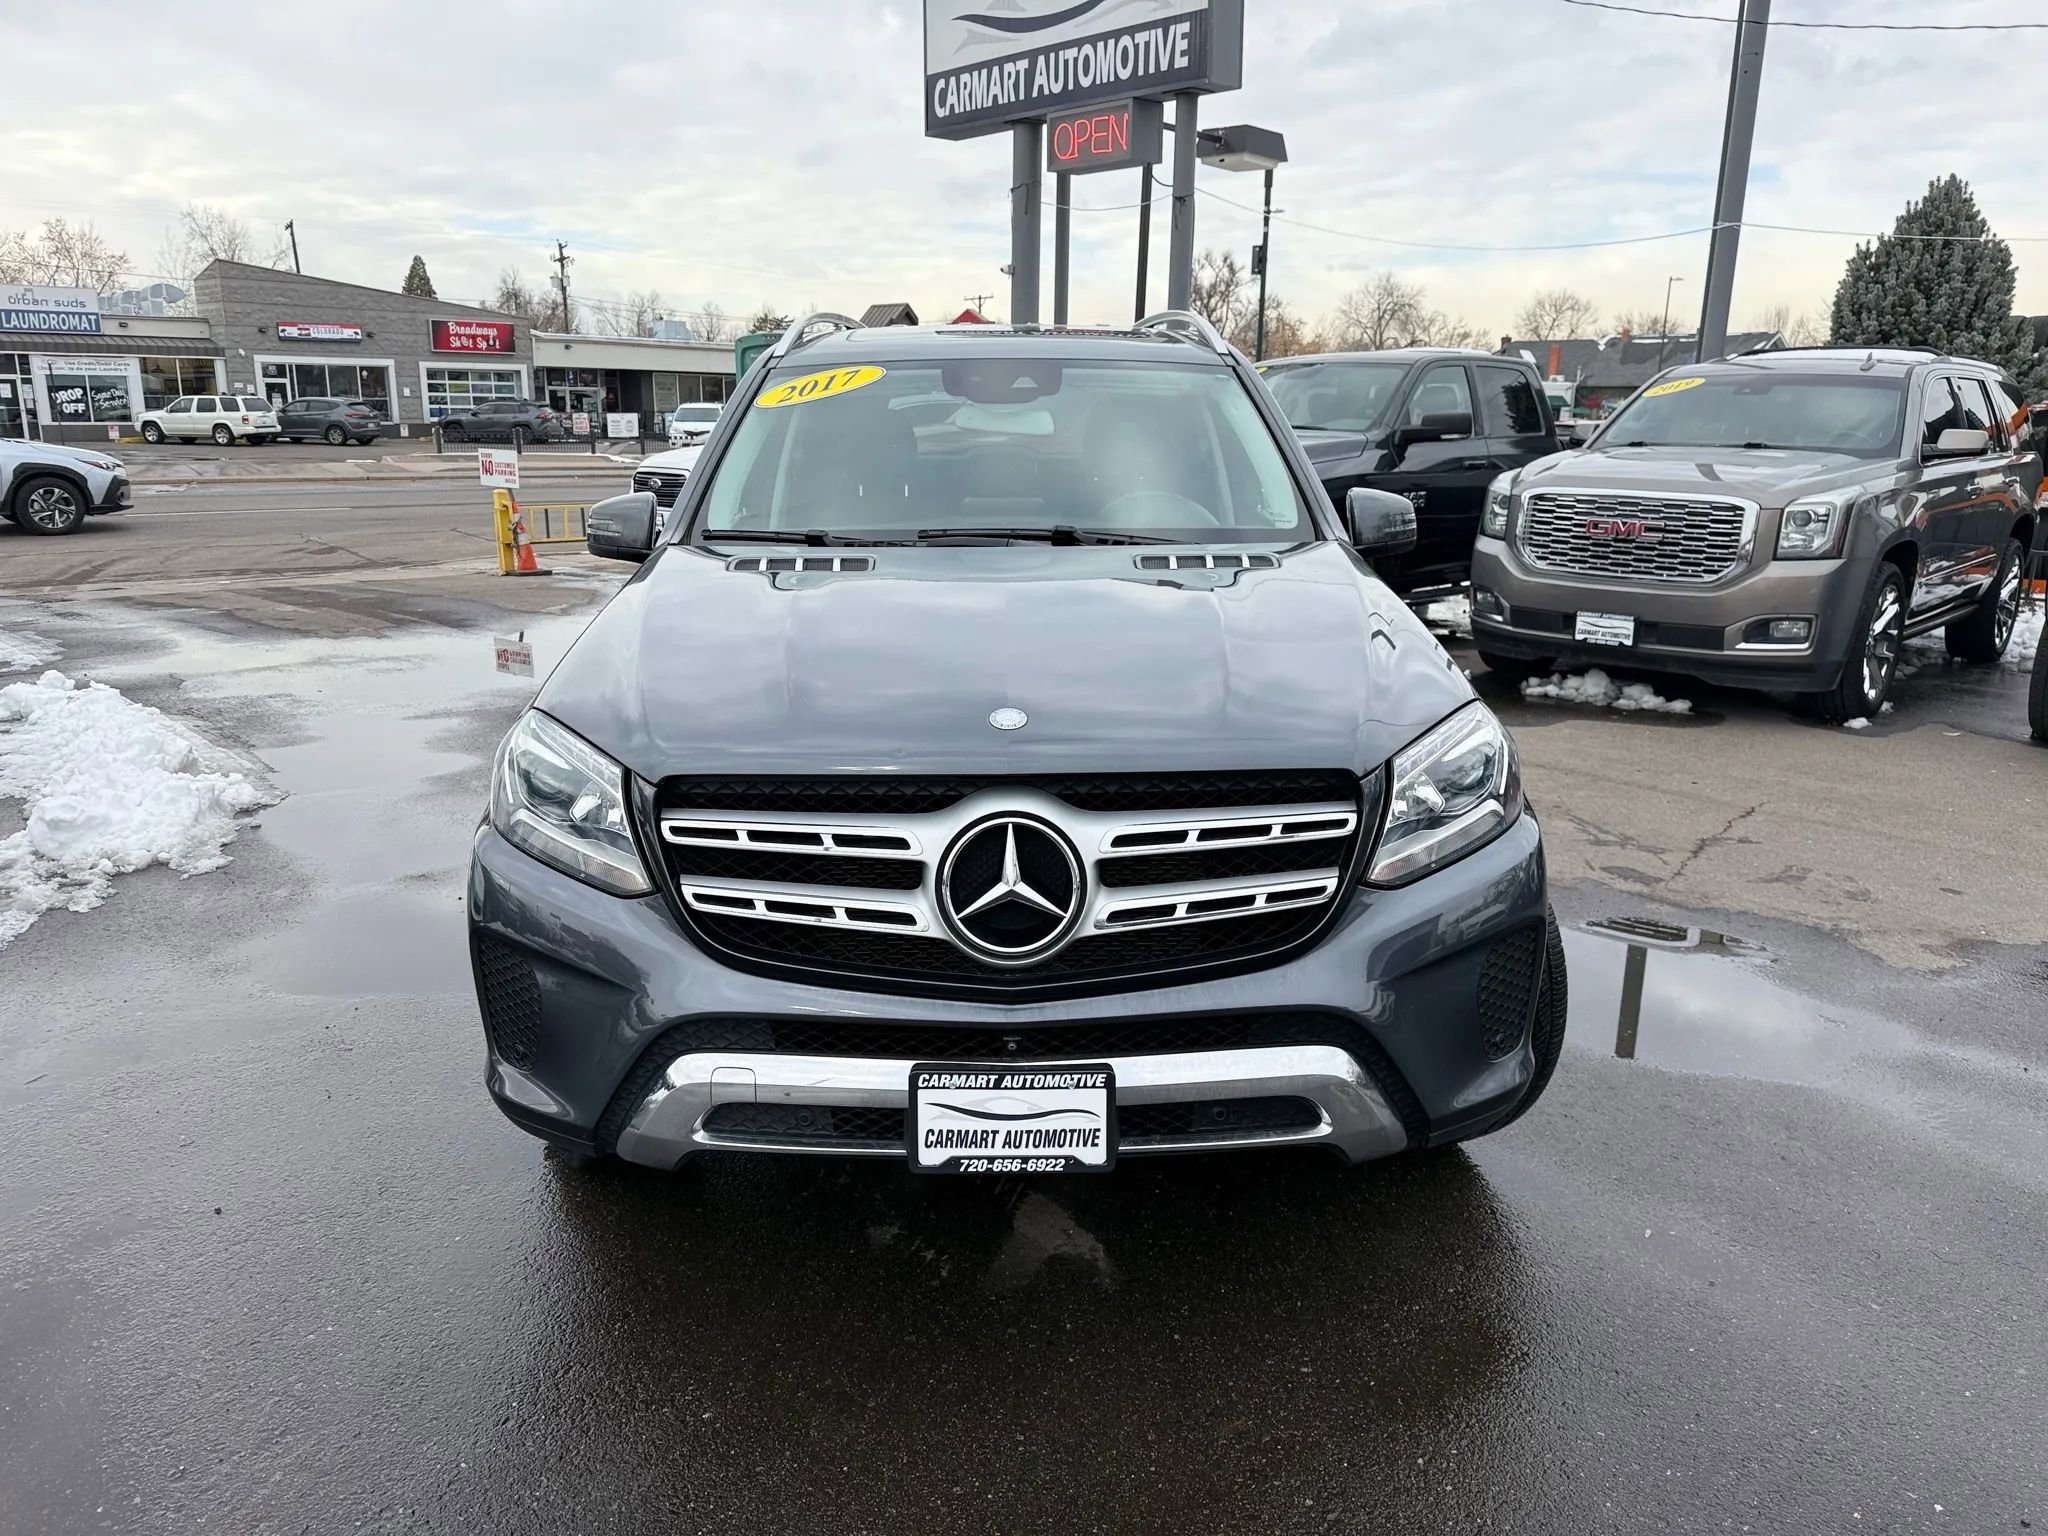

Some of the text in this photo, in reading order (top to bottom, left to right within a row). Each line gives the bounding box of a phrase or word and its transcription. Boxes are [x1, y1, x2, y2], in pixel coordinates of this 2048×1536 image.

[933, 21, 1190, 118] CARMART AUTOMOTIVE
[1053, 112, 1129, 160] OPEN
[54, 298, 87, 308] suds
[1, 311, 97, 331] LAUNDROMAT
[448, 321, 498, 336] Broadways
[776, 369, 862, 404] 2017
[62, 403, 86, 414] OFF
[481, 459, 494, 476] NO
[494, 469, 517, 477] PARKING
[1584, 517, 1665, 540] GMC
[1577, 628, 1600, 636] CARMART
[918, 1074, 1107, 1089] CARMART AUTOMOTIVE
[924, 1127, 1101, 1149] CARMART AUTOMOTIVE
[959, 1158, 1066, 1172] 720-656-6922
